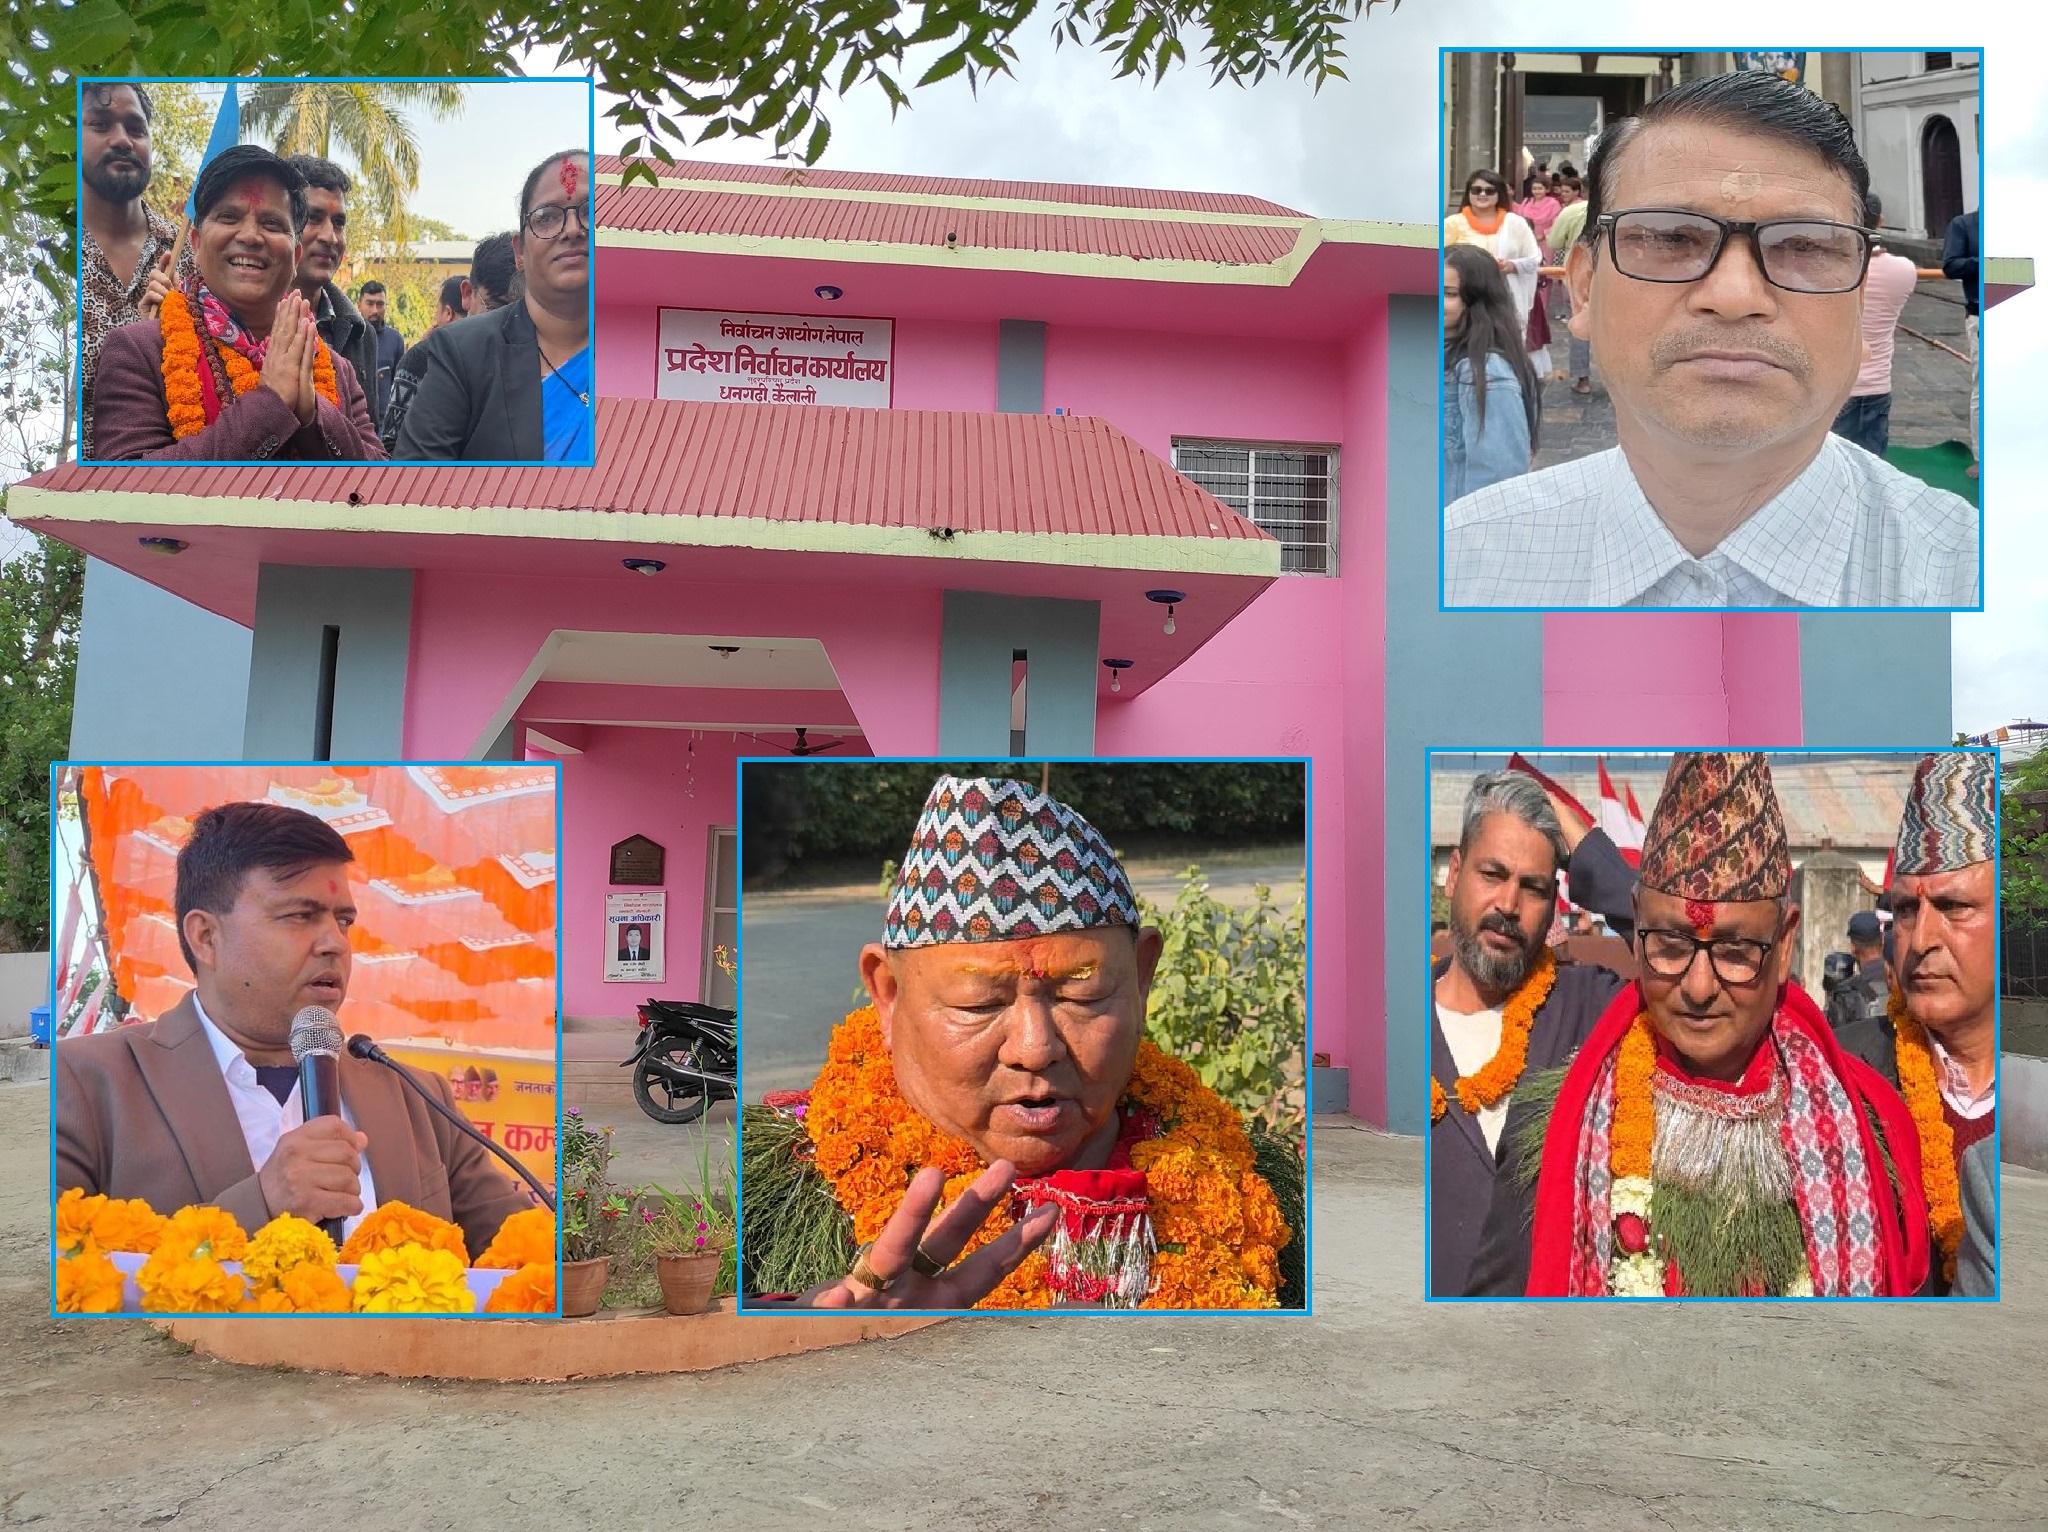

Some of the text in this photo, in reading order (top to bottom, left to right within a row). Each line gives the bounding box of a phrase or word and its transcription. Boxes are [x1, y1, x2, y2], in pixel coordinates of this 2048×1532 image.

[720, 318, 775, 340] निर्वाचन
[825, 324, 864, 347] नेपाल
[664, 342, 888, 382] प्रदेश निर्वाचन कार्यालय
[771, 382, 817, 405] कैलाली
